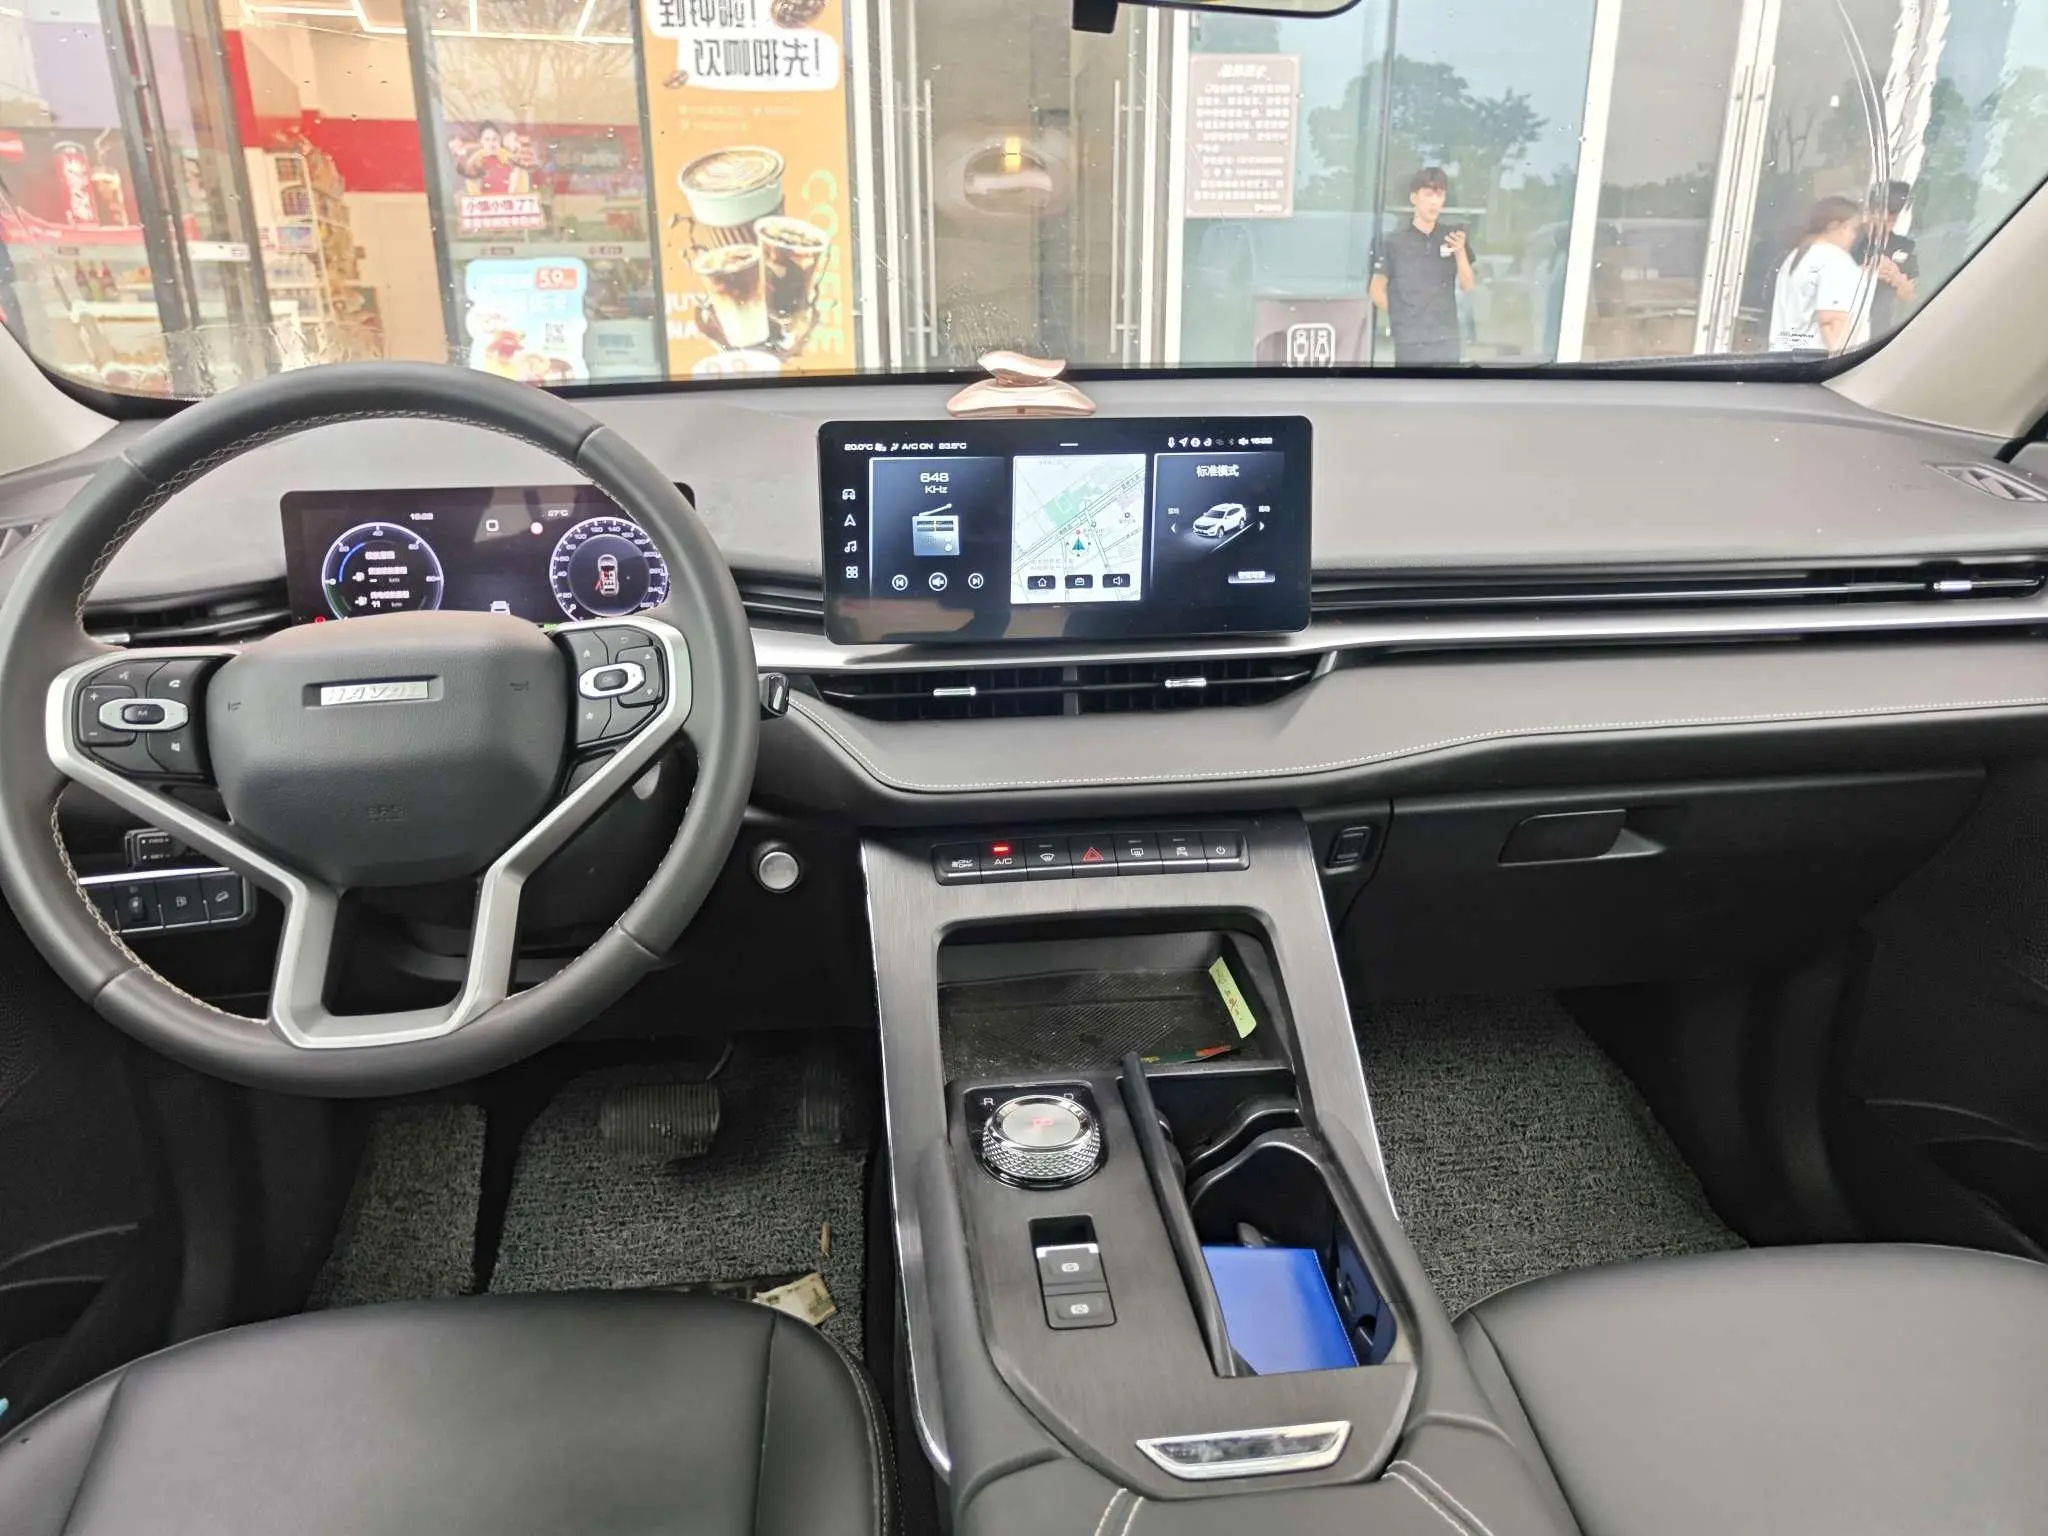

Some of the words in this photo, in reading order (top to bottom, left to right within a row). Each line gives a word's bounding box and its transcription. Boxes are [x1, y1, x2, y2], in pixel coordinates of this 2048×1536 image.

[693, 37, 821, 77] 饮咖啡先!
[919, 442, 934, 450] ON
[1196, 464, 1240, 477] 标准模式
[919, 472, 950, 483] 648
[925, 485, 948, 494] KHz
[994, 858, 1013, 866] A/C
[983, 1097, 994, 1106] R
